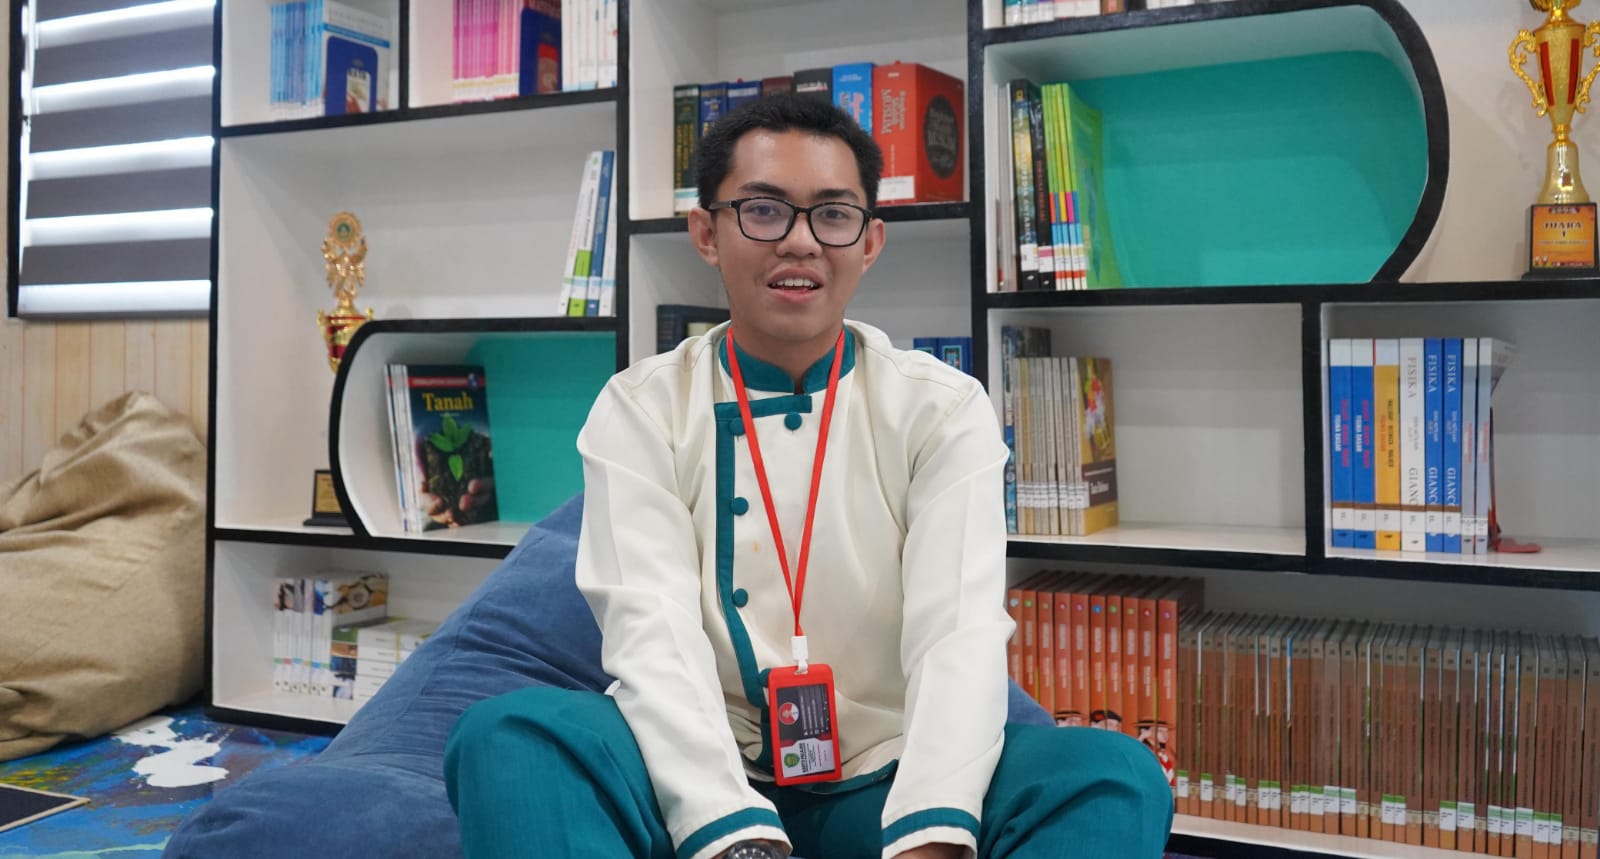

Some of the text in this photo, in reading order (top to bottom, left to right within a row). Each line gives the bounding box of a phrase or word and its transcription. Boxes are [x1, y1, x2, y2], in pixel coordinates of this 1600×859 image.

[880, 88, 892, 135] MUSLIM
[422, 391, 474, 412] Tanah
[1407, 356, 1419, 506] FISIKA GIANC
[1428, 354, 1439, 506] FISIKA GIANC
[1446, 354, 1457, 506] FISIKA GIANC
